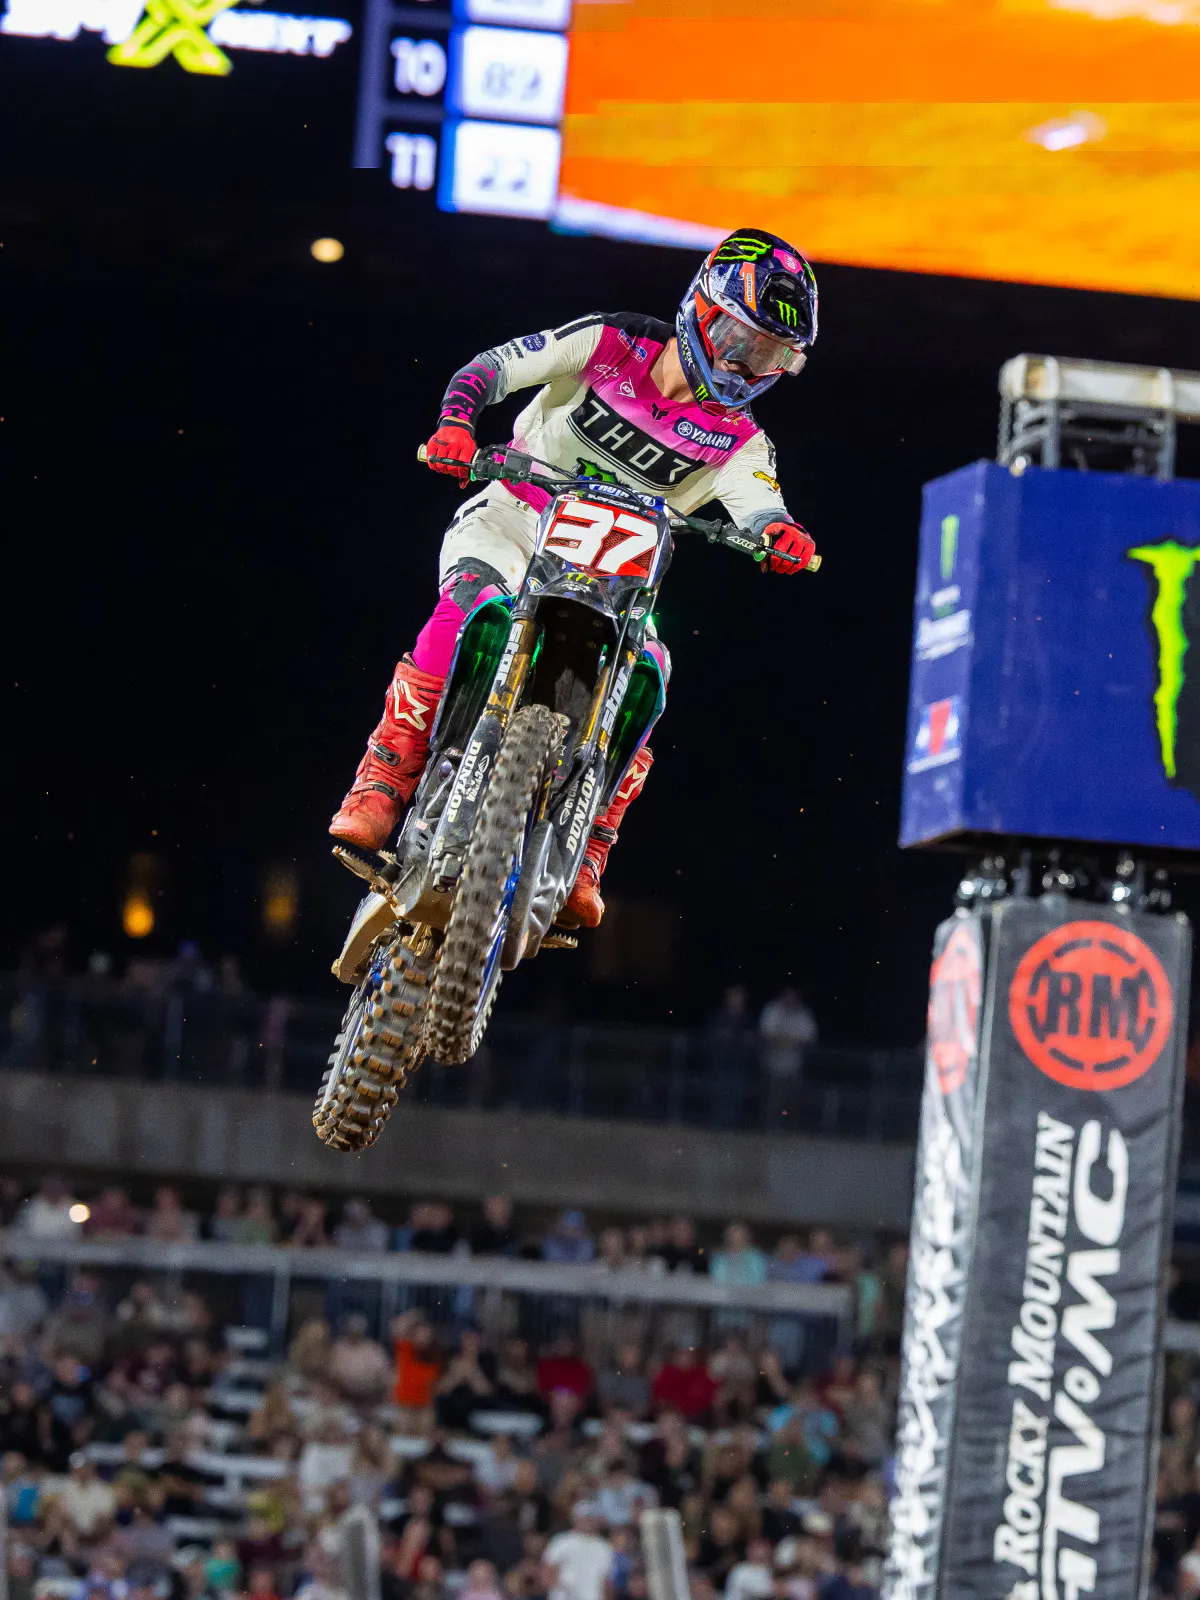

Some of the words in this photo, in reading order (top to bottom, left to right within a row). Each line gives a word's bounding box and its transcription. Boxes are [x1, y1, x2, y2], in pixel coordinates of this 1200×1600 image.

[390, 36, 447, 96] 10
[385, 132, 437, 190] 11
[545, 500, 658, 575] 37
[447, 740, 482, 823] DUNLOP
[566, 767, 596, 856] DUNLOP
[1008, 1110, 1074, 1401] MOUNTAIN
[994, 1398, 1049, 1577] ROCKY
